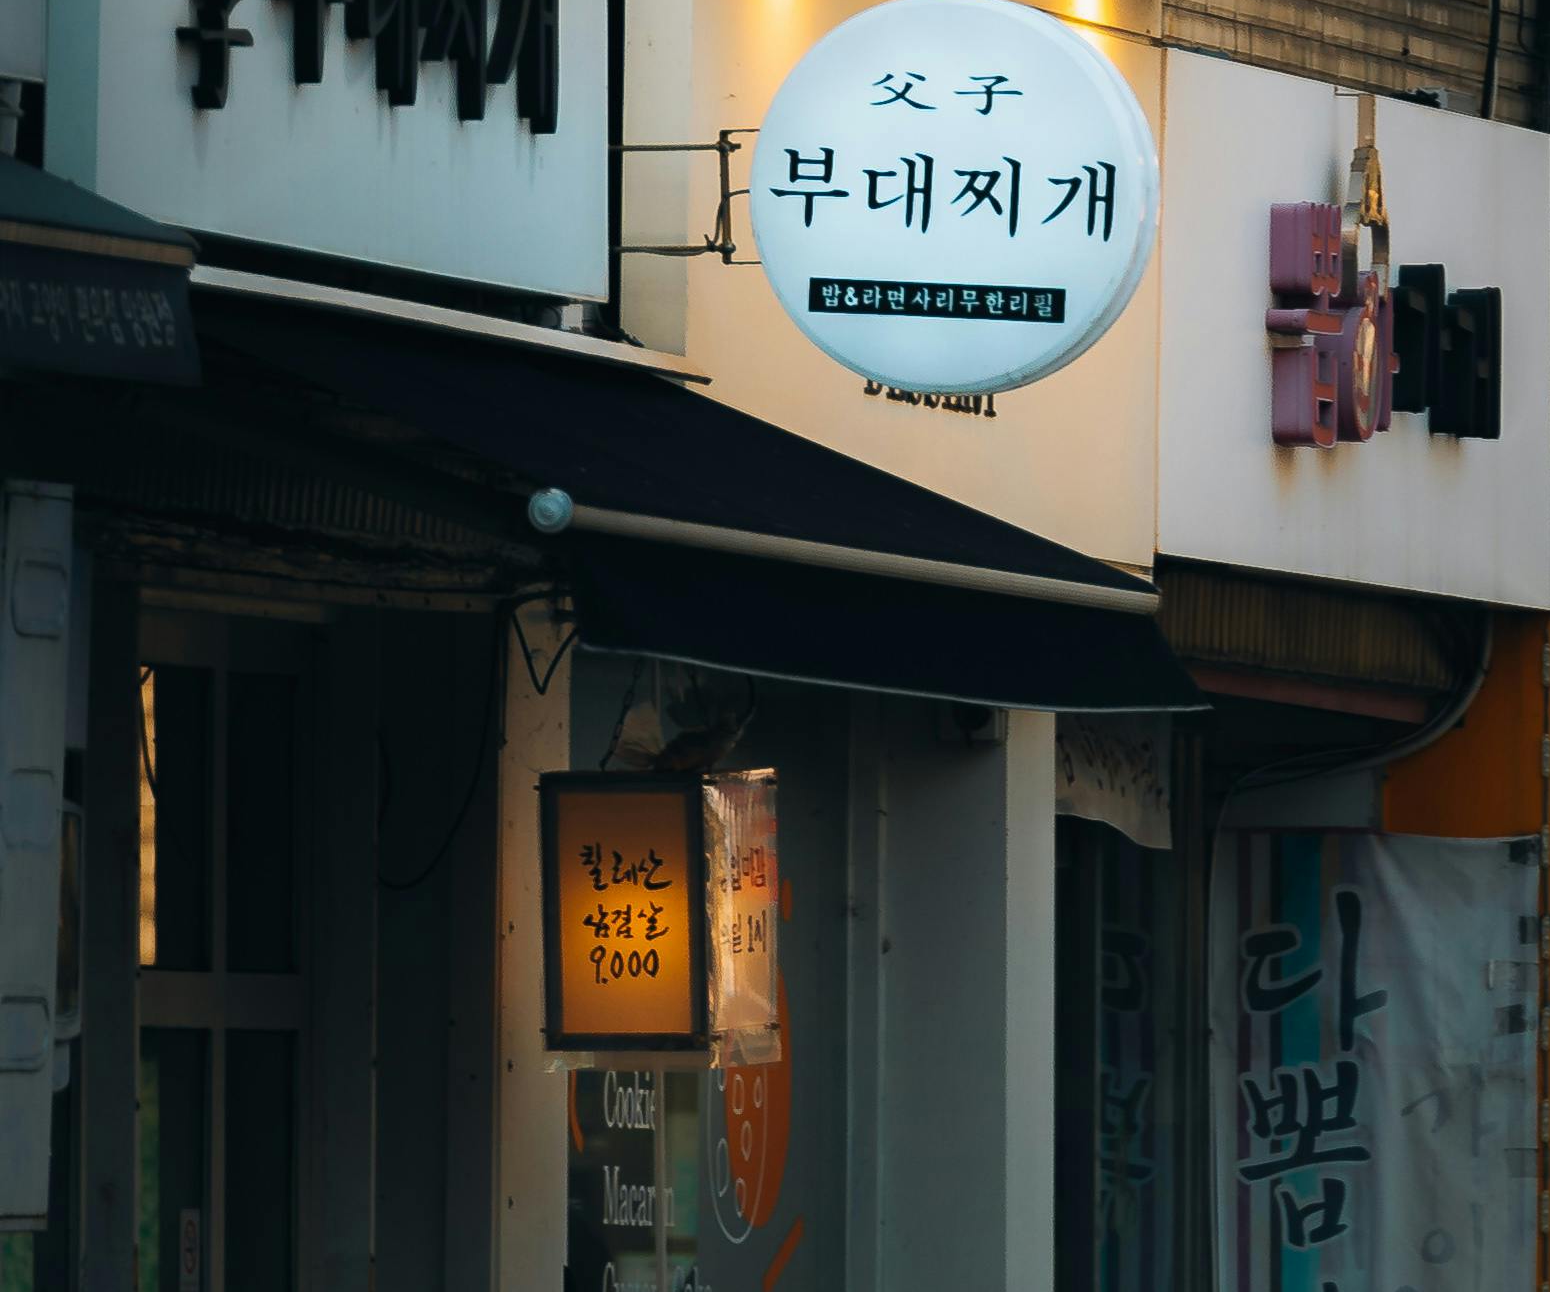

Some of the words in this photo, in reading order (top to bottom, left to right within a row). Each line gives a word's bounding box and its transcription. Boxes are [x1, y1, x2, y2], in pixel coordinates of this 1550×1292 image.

[768, 146, 1118, 242] 부대찌개
[579, 842, 673, 892] 칠레산
[603, 1165, 676, 1227] Macarn
